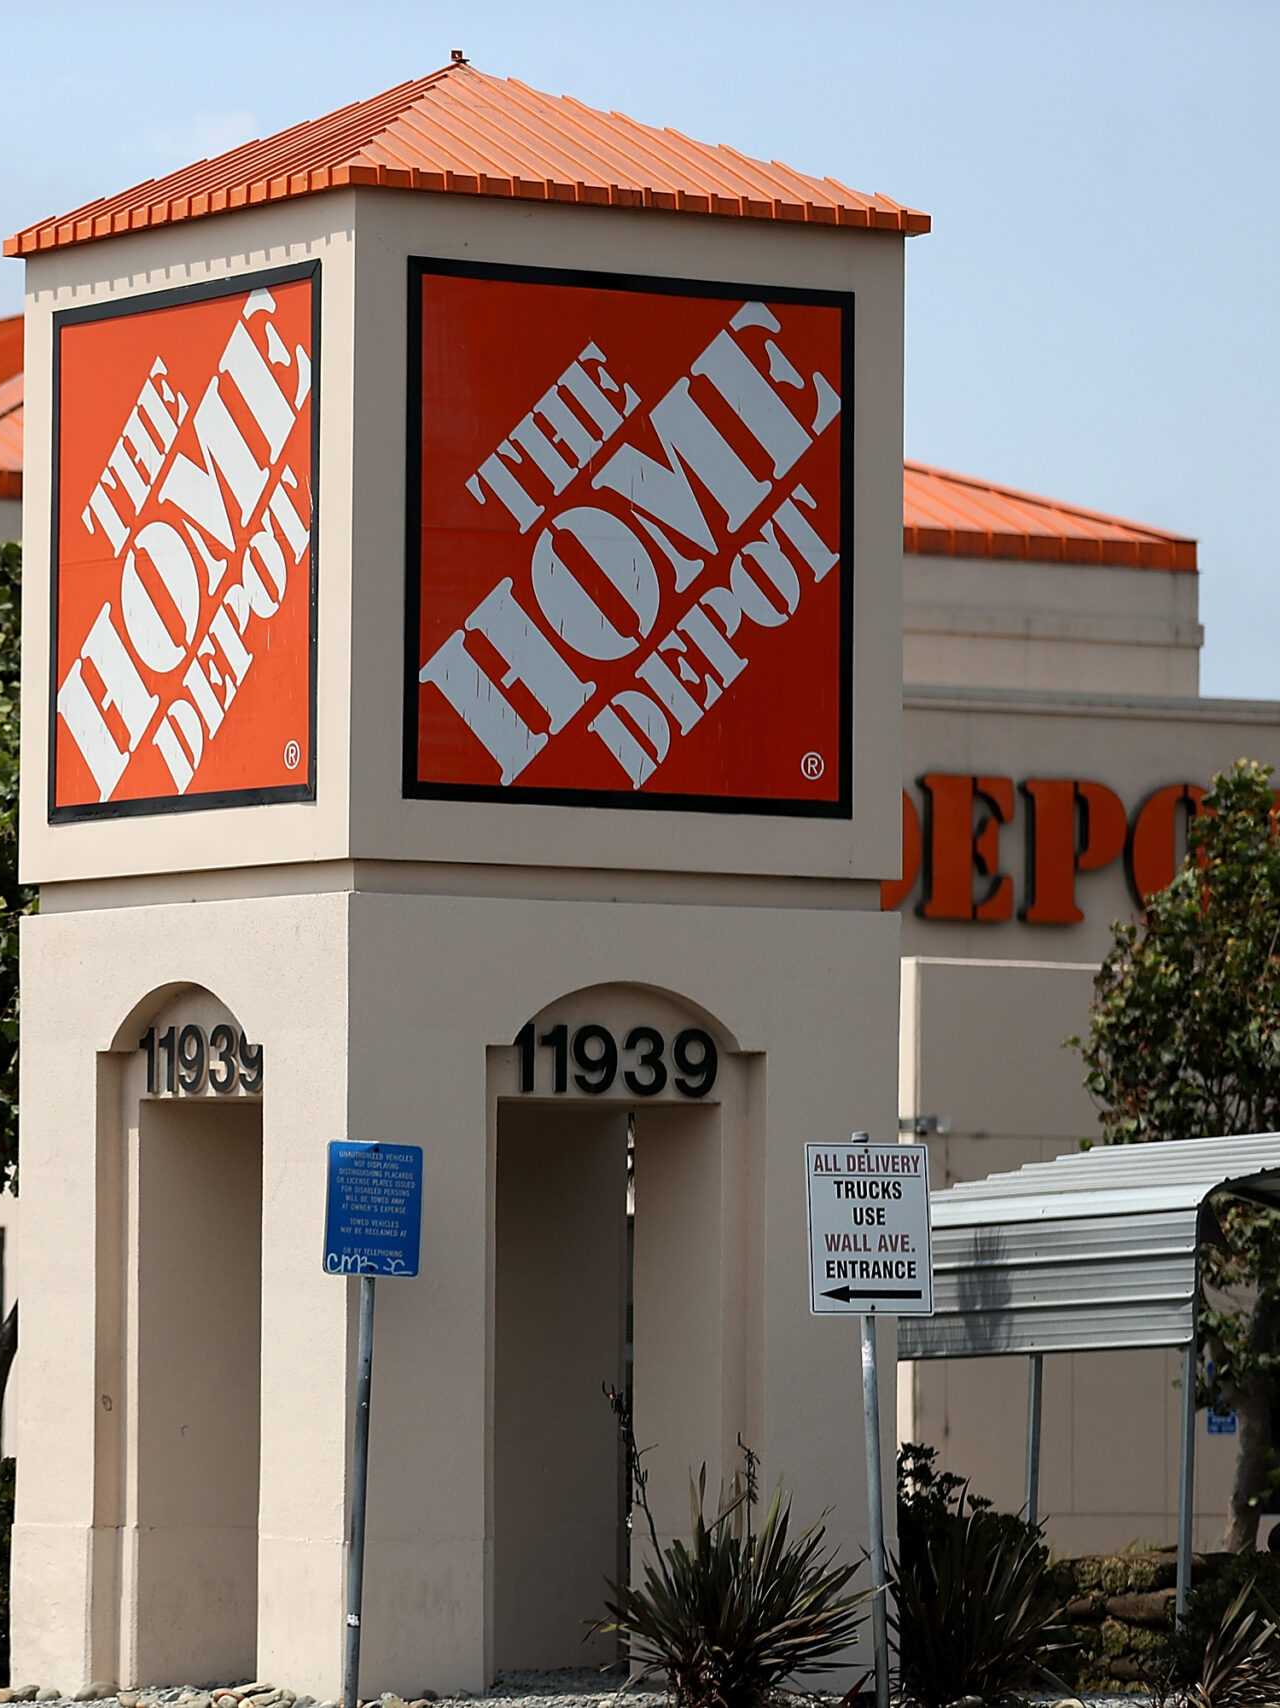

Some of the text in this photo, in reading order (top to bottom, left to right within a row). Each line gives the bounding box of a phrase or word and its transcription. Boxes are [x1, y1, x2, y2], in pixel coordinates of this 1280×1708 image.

[465, 341, 642, 534] THE
[82, 356, 189, 558] THE
[57, 288, 311, 802] HOME
[419, 300, 842, 786] HOME
[152, 465, 310, 795] DEPOT
[588, 483, 840, 789] DEPOT
[139, 1024, 263, 1094] 11939
[516, 1023, 719, 1098] 11939
[386, 1154, 413, 1162] VEHICLES
[814, 1154, 920, 1173] ALL DELIVERY
[341, 1185, 410, 1197] FOR DISABLED PERSONS
[347, 1177, 369, 1186] LICENSE
[372, 1179, 393, 1188] PLATES
[834, 1181, 902, 1199] TRUCKS
[345, 1194, 358, 1202] WILL
[361, 1195, 369, 1203] BE
[371, 1196, 389, 1204] TOWED
[380, 1205, 407, 1214] EXPENSE
[853, 1207, 886, 1226] USE
[340, 1226, 407, 1238] MAY BE RECLAIMED AT
[350, 1217, 399, 1229] TOWED VEHICLES
[825, 1234, 916, 1253] WALL AVE.
[826, 1260, 916, 1279] ENTRANCE
